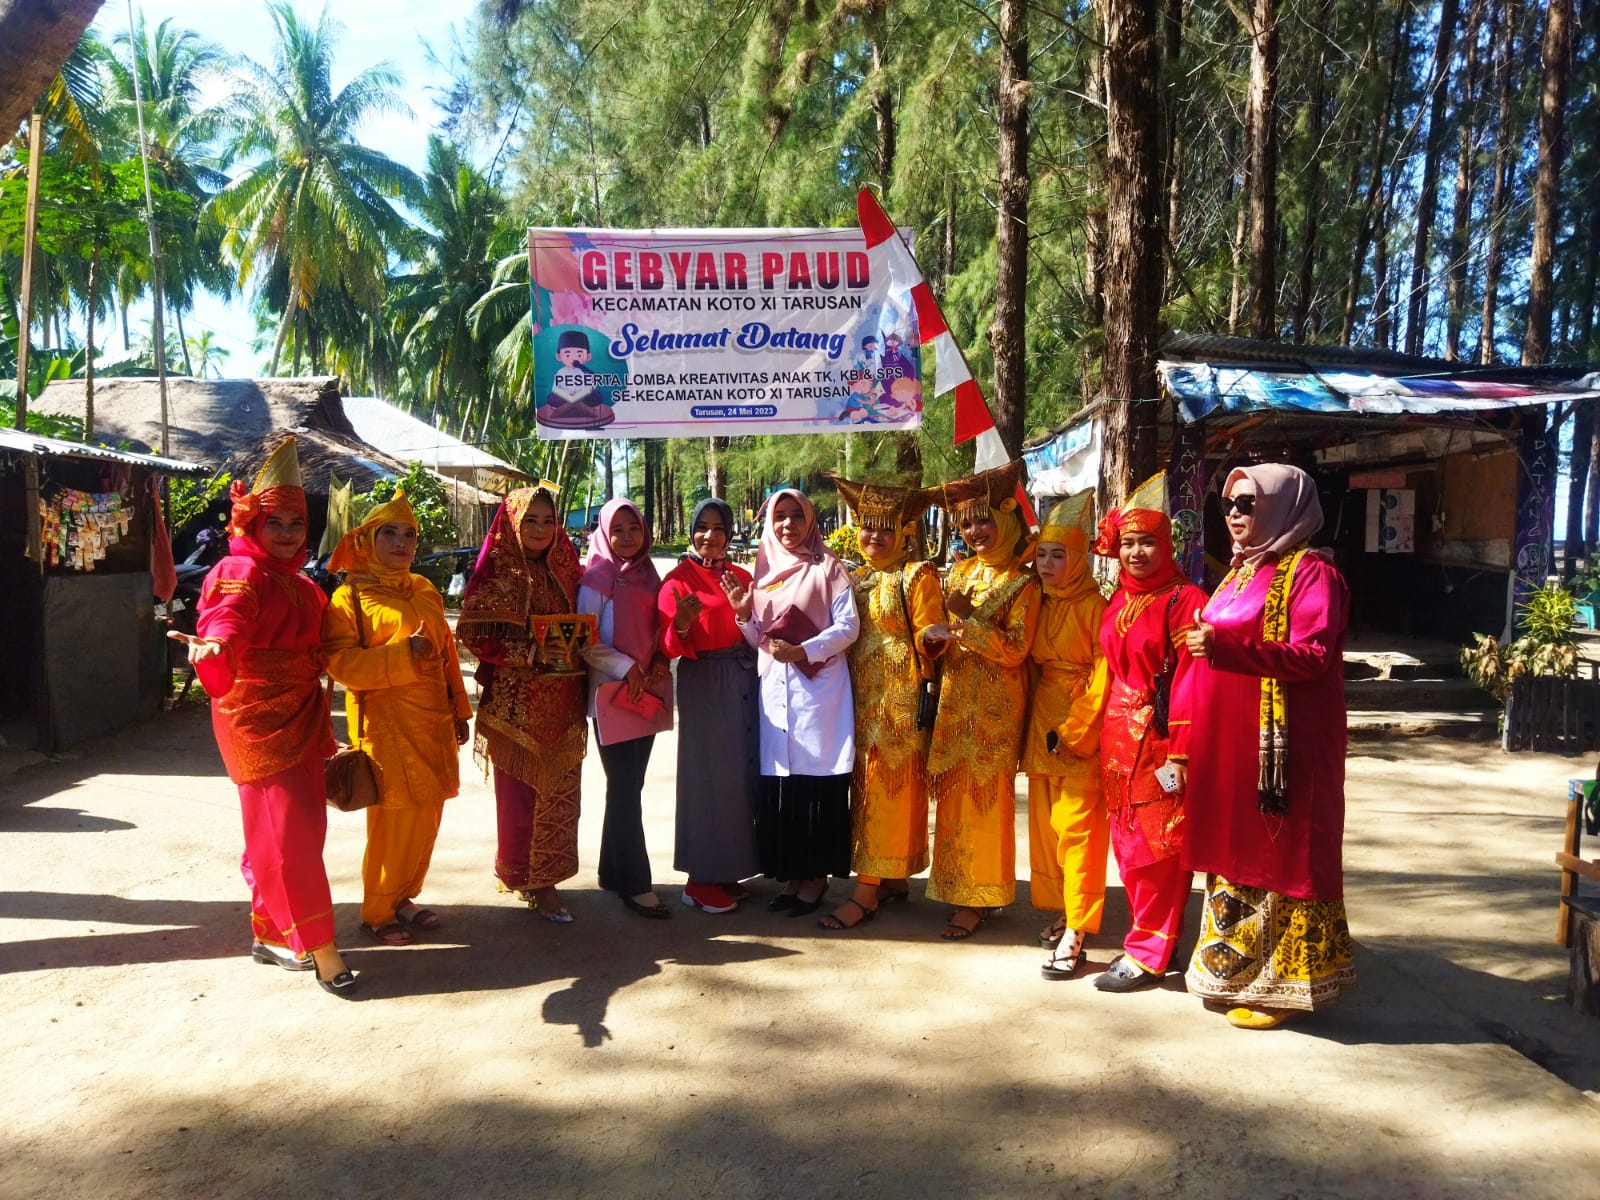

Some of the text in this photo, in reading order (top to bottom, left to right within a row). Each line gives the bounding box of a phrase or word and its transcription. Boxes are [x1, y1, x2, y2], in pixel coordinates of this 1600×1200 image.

[581, 250, 870, 292] GEBYAR PAUD
[592, 295, 862, 311] KECAMATAN KOTO XI TARUSAN
[611, 322, 847, 360] Selamat Datang
[555, 367, 903, 387] PESERTA LOMBA KREATIVITAS ANAK TK, KB & SPS
[612, 386, 851, 402] SE-KECAMATAN KOTO XI TARUSAN
[694, 407, 774, 417] Tarusan, 24 Mei 2023
